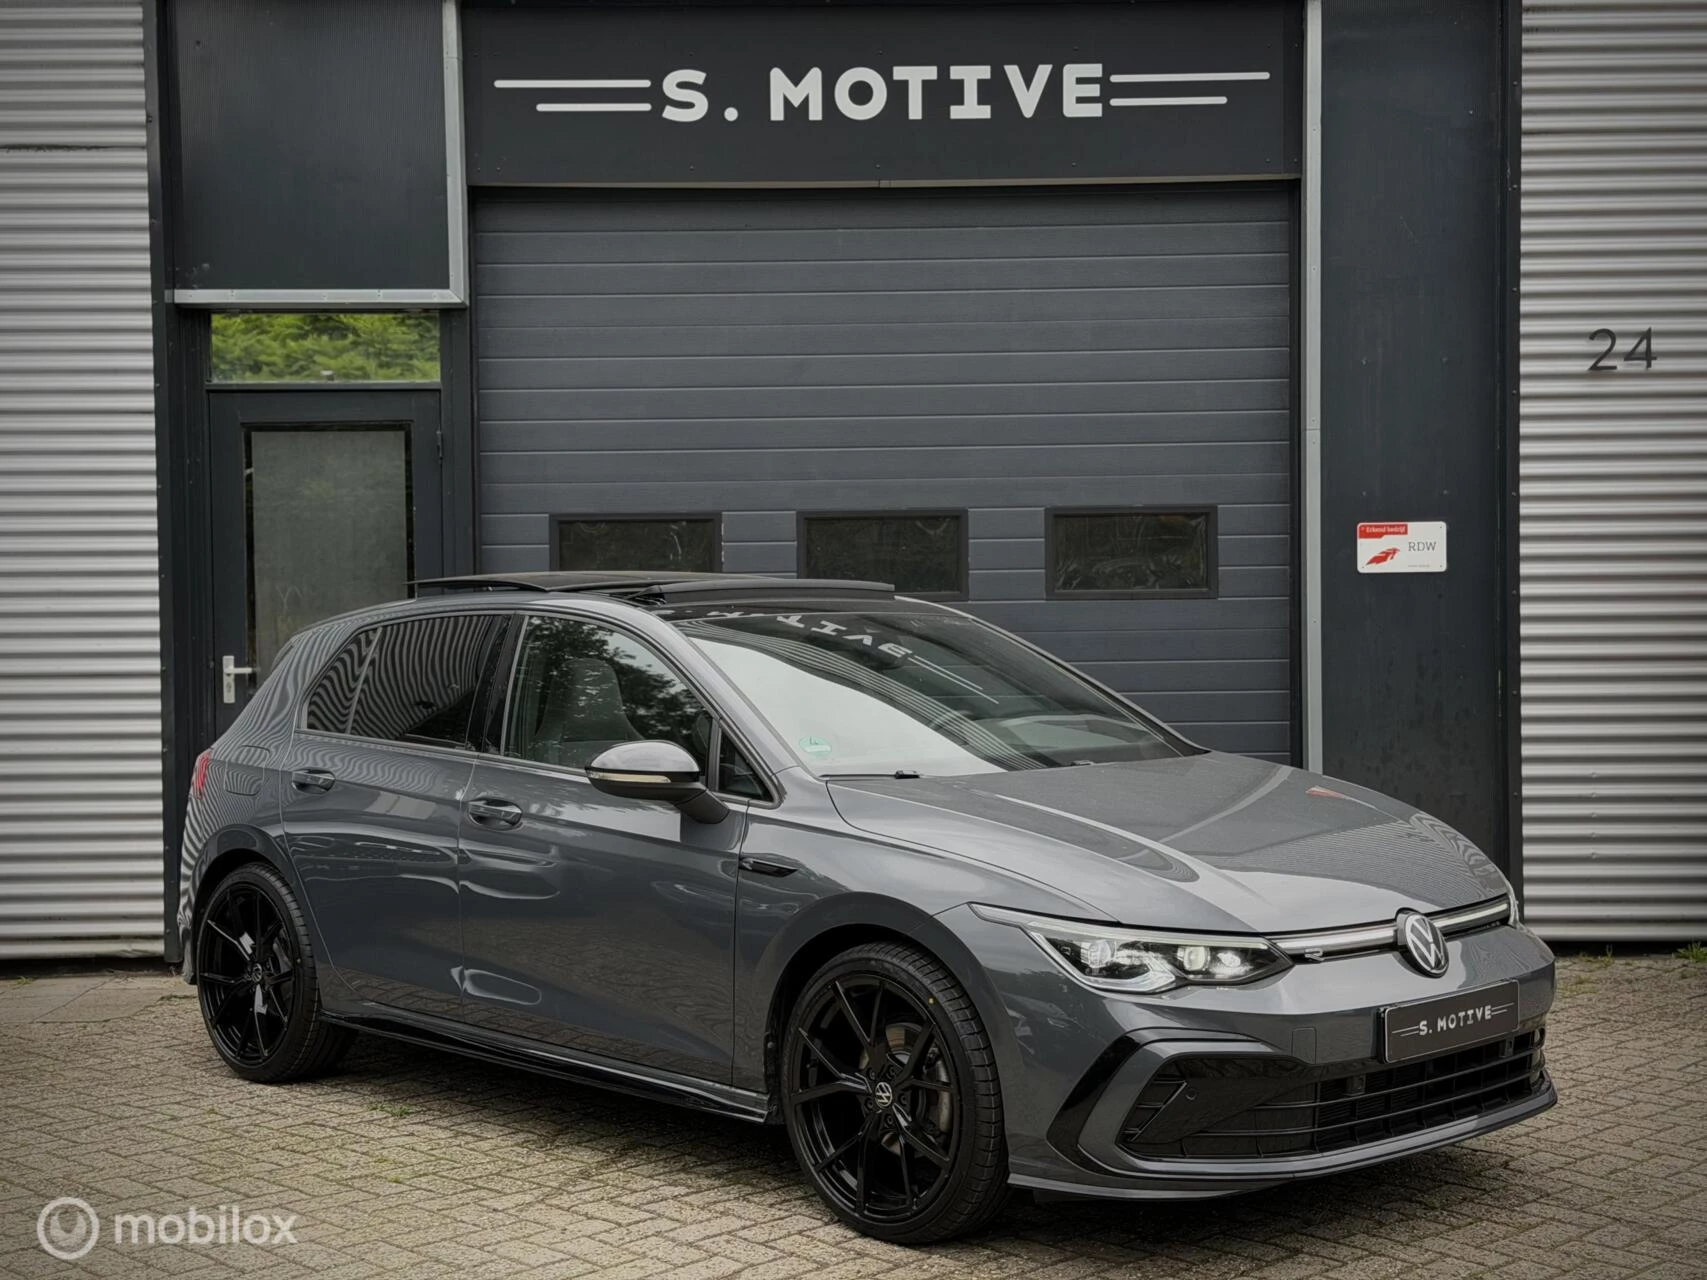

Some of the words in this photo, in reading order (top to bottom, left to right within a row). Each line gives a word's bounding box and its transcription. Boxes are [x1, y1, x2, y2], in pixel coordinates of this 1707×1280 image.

[662, 69, 739, 122] S.
[769, 63, 1103, 121] MOTIVE
[1588, 327, 1657, 371] 24
[1408, 541, 1437, 552] RDW
[1419, 1020, 1433, 1036] S.
[1437, 1005, 1492, 1032] MOTIVE
